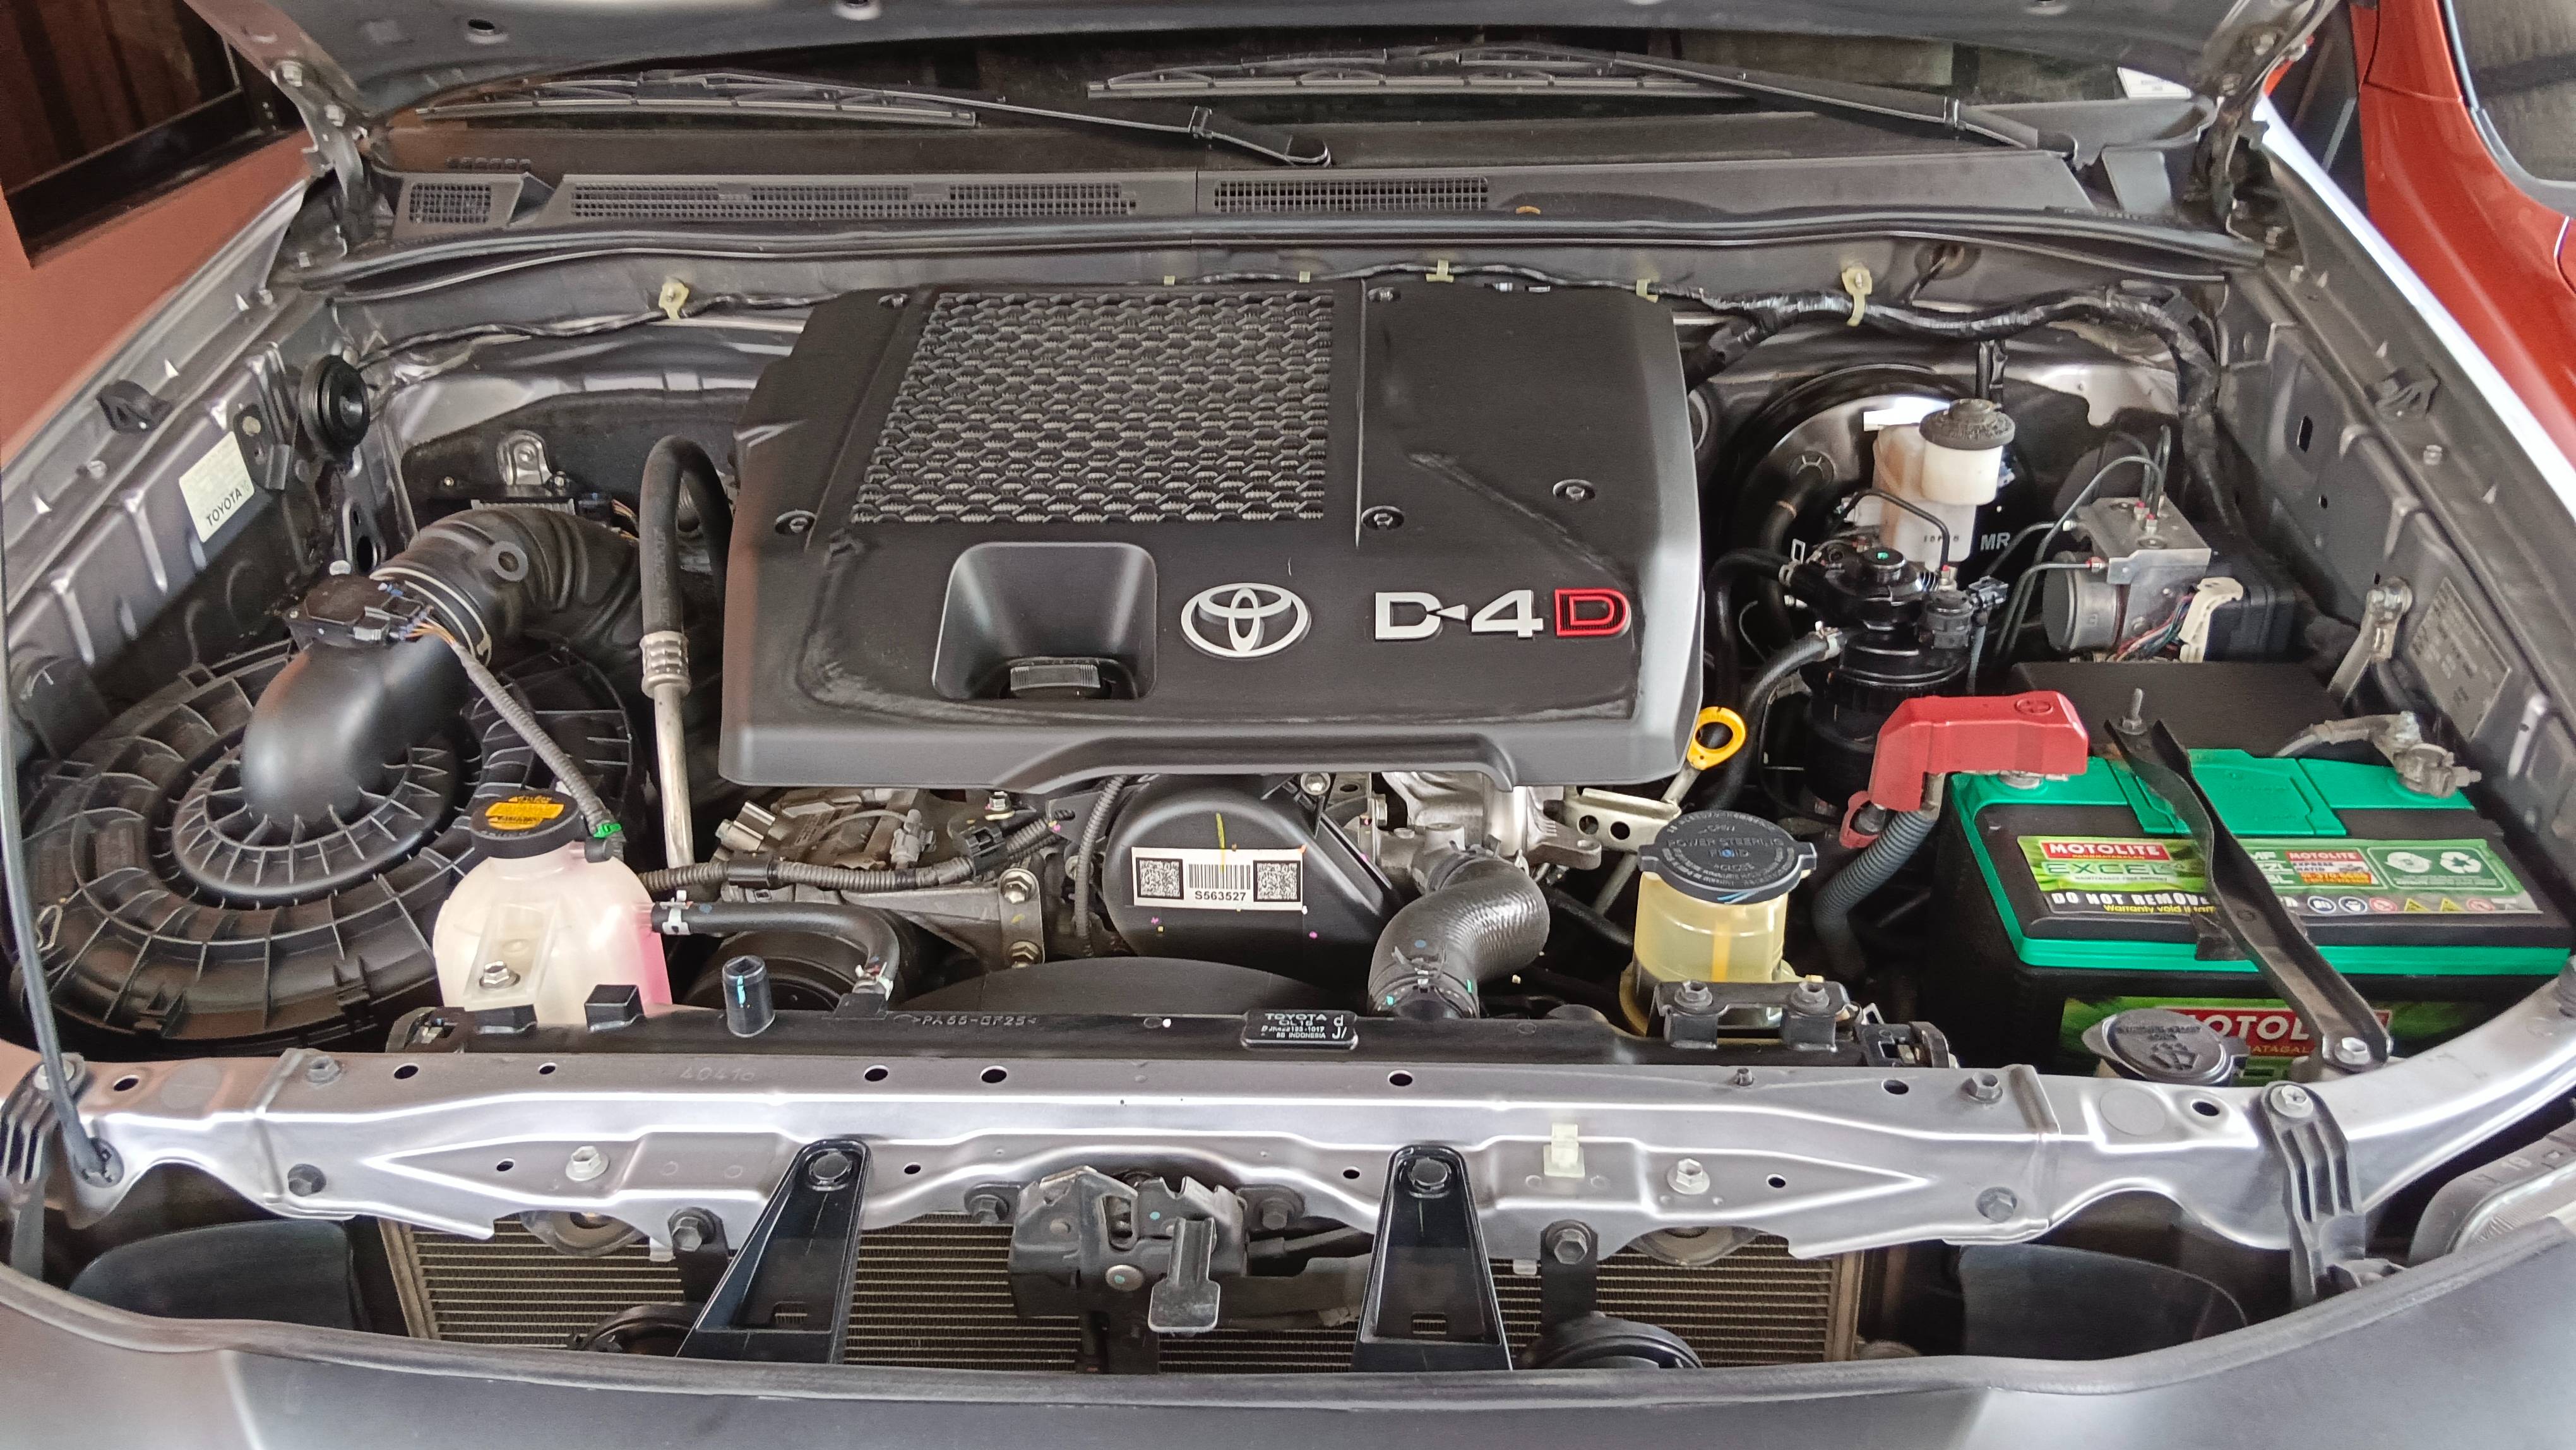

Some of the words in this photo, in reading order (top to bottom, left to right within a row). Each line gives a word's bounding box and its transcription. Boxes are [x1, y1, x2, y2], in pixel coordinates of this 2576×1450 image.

[206, 488, 242, 526] TOYOTA
[1980, 532, 2010, 551] MR
[1374, 589, 1631, 639] D-4D
[2049, 843, 2160, 856] MOTOLITE
[2045, 863, 2177, 875] EXCEL
[1195, 890, 1246, 901] S563527
[2052, 892, 2079, 904] DO
[2085, 893, 2124, 905] NOT
[2104, 905, 2154, 914] Warranty
[2157, 904, 2182, 913] void
[1265, 1013, 1327, 1021] TOYOTA
